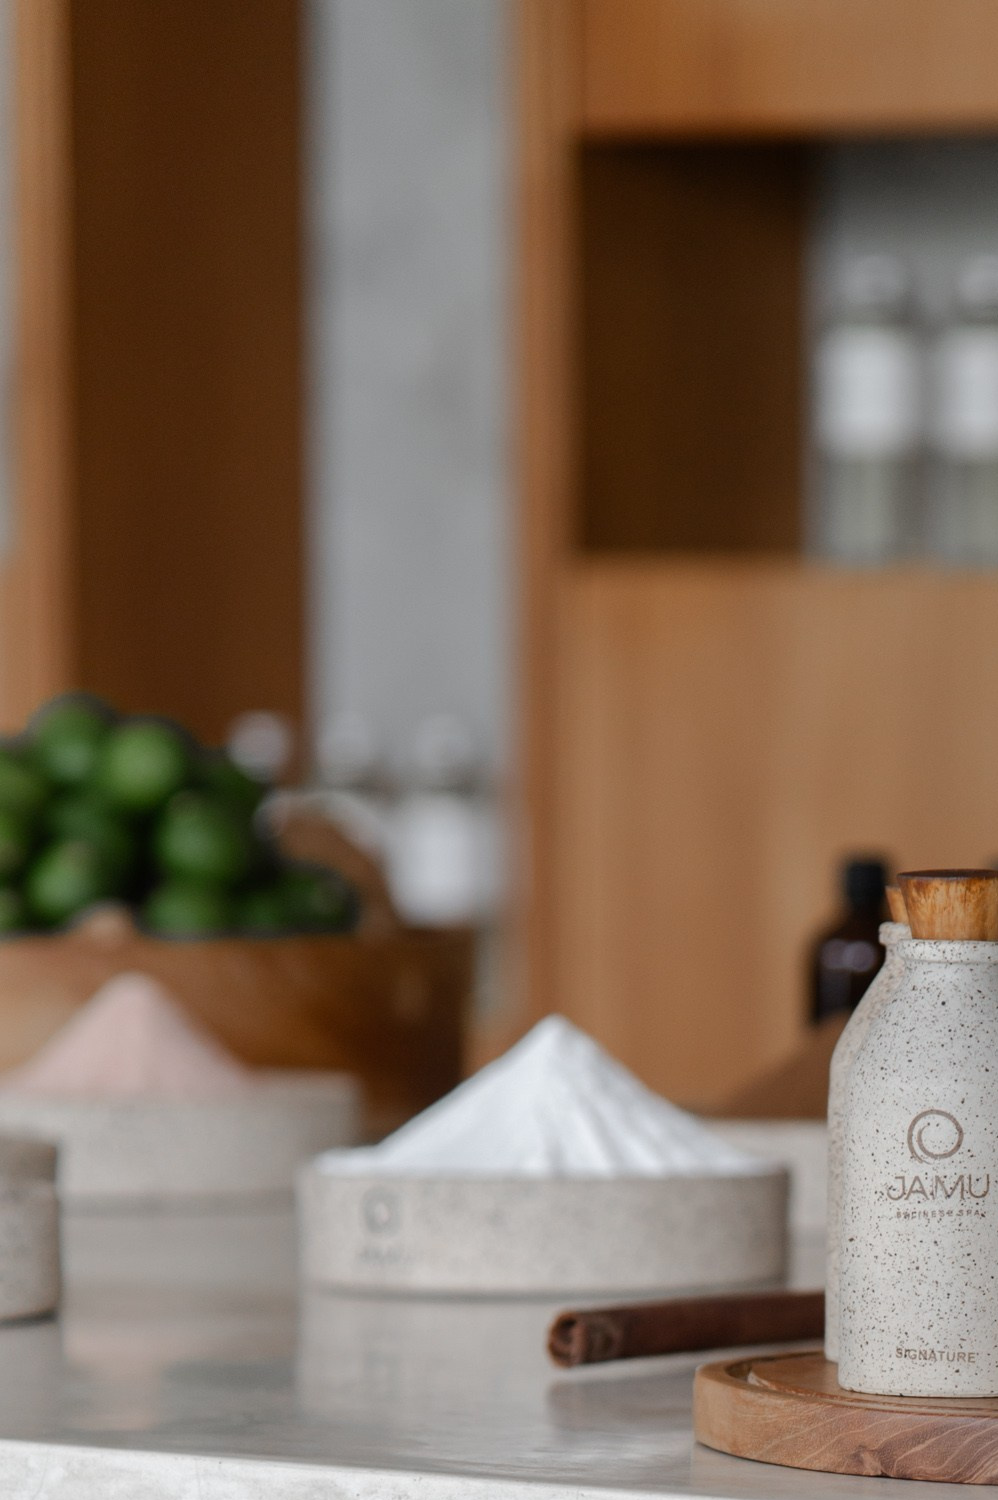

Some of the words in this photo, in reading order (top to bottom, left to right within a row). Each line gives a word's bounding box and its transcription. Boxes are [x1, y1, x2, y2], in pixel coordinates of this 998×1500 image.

[886, 1173, 990, 1201] JAMU
[956, 1208, 980, 1218] SPA
[895, 1346, 976, 1364] SIGNATURE
